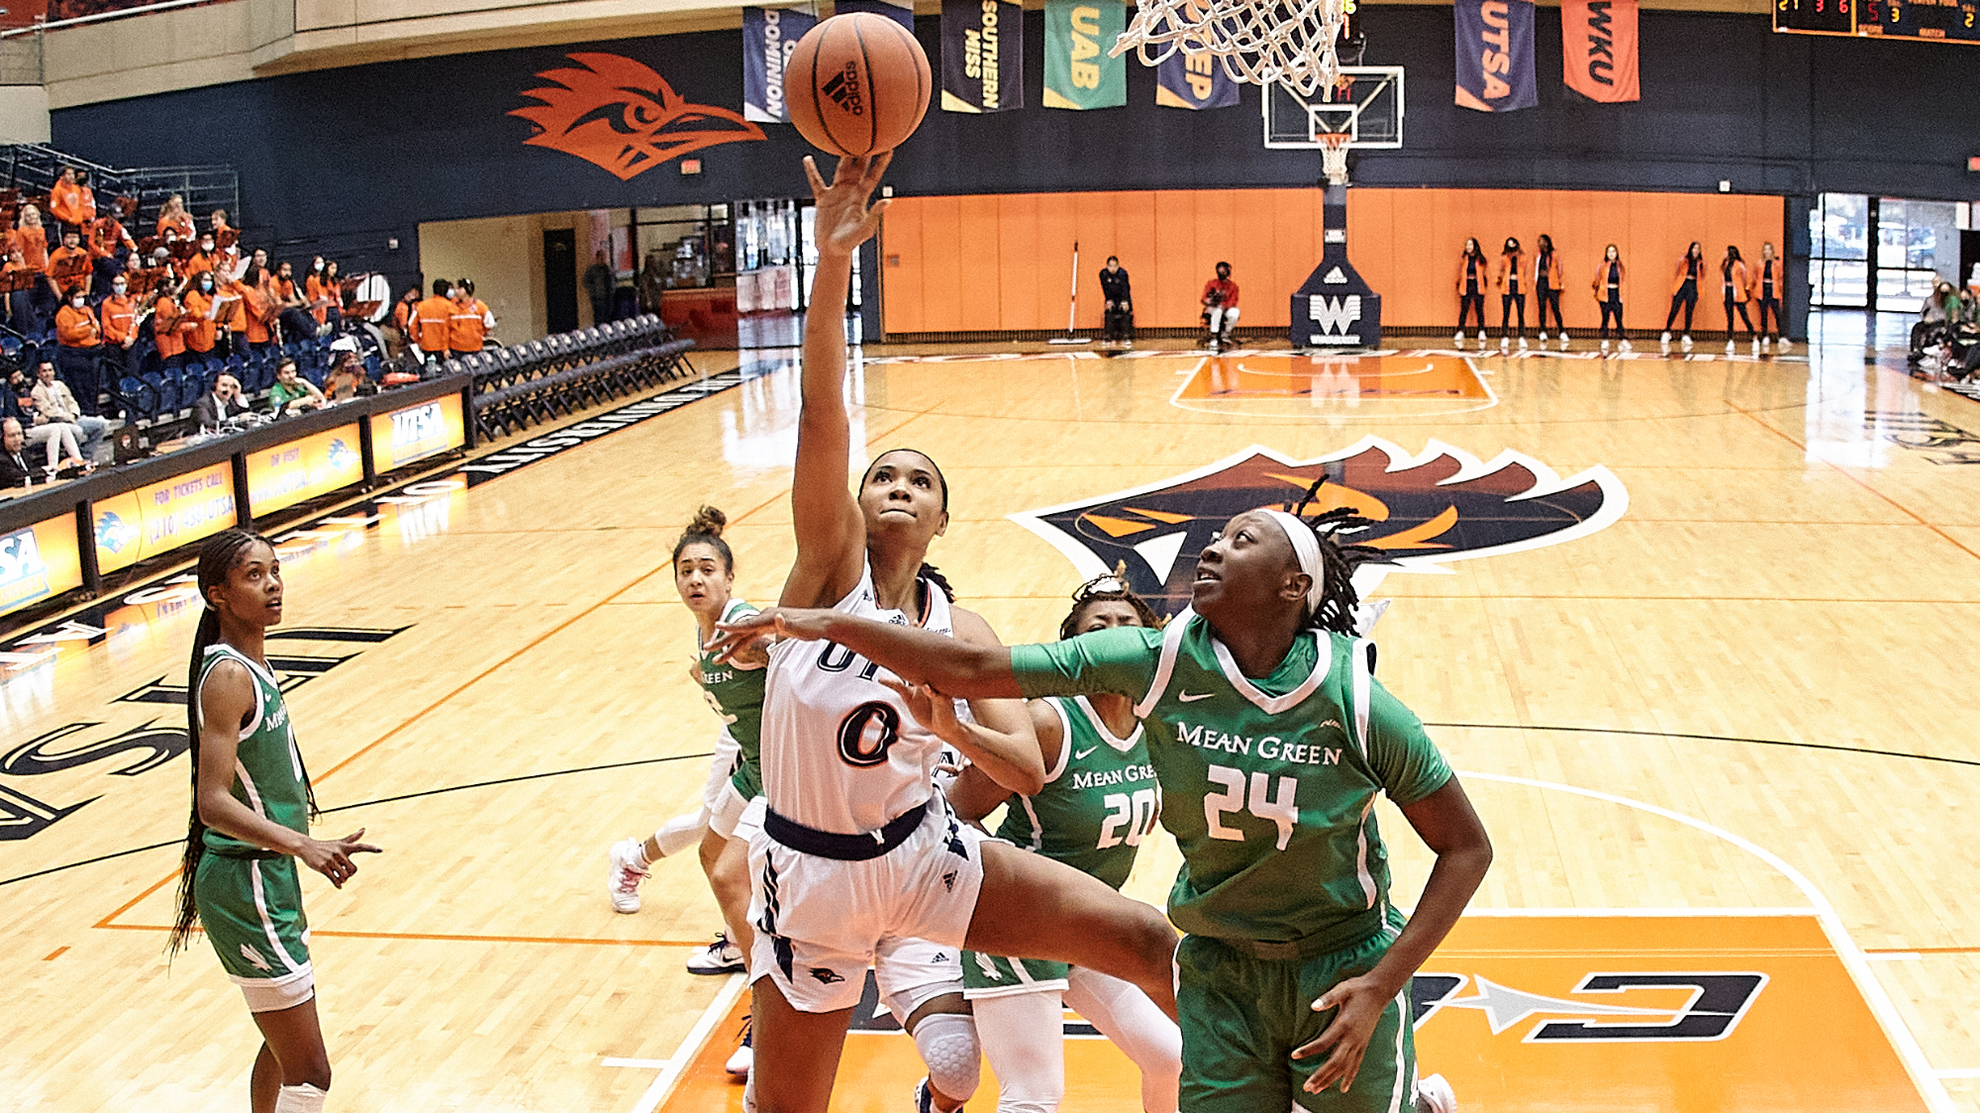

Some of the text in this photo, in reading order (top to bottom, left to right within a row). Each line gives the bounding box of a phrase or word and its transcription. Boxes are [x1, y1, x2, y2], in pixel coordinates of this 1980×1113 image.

[764, 10, 784, 117] DOMINION
[965, 29, 981, 79] MISS
[982, 0, 999, 108] SOUTHERN
[1071, 6, 1100, 90] UAB
[1481, 1, 1511, 100] UTSA
[1588, 2, 1614, 86] WKU
[846, 61, 863, 116] adidas
[389, 403, 446, 446] UTSA
[154, 471, 223, 506] FOR TICKETS CALL
[836, 700, 900, 768] 0
[1176, 721, 1343, 766] MEAN GREEN
[1072, 763, 1158, 791] MEAN GRE
[1204, 763, 1299, 851] 24
[1095, 787, 1158, 850] 20
